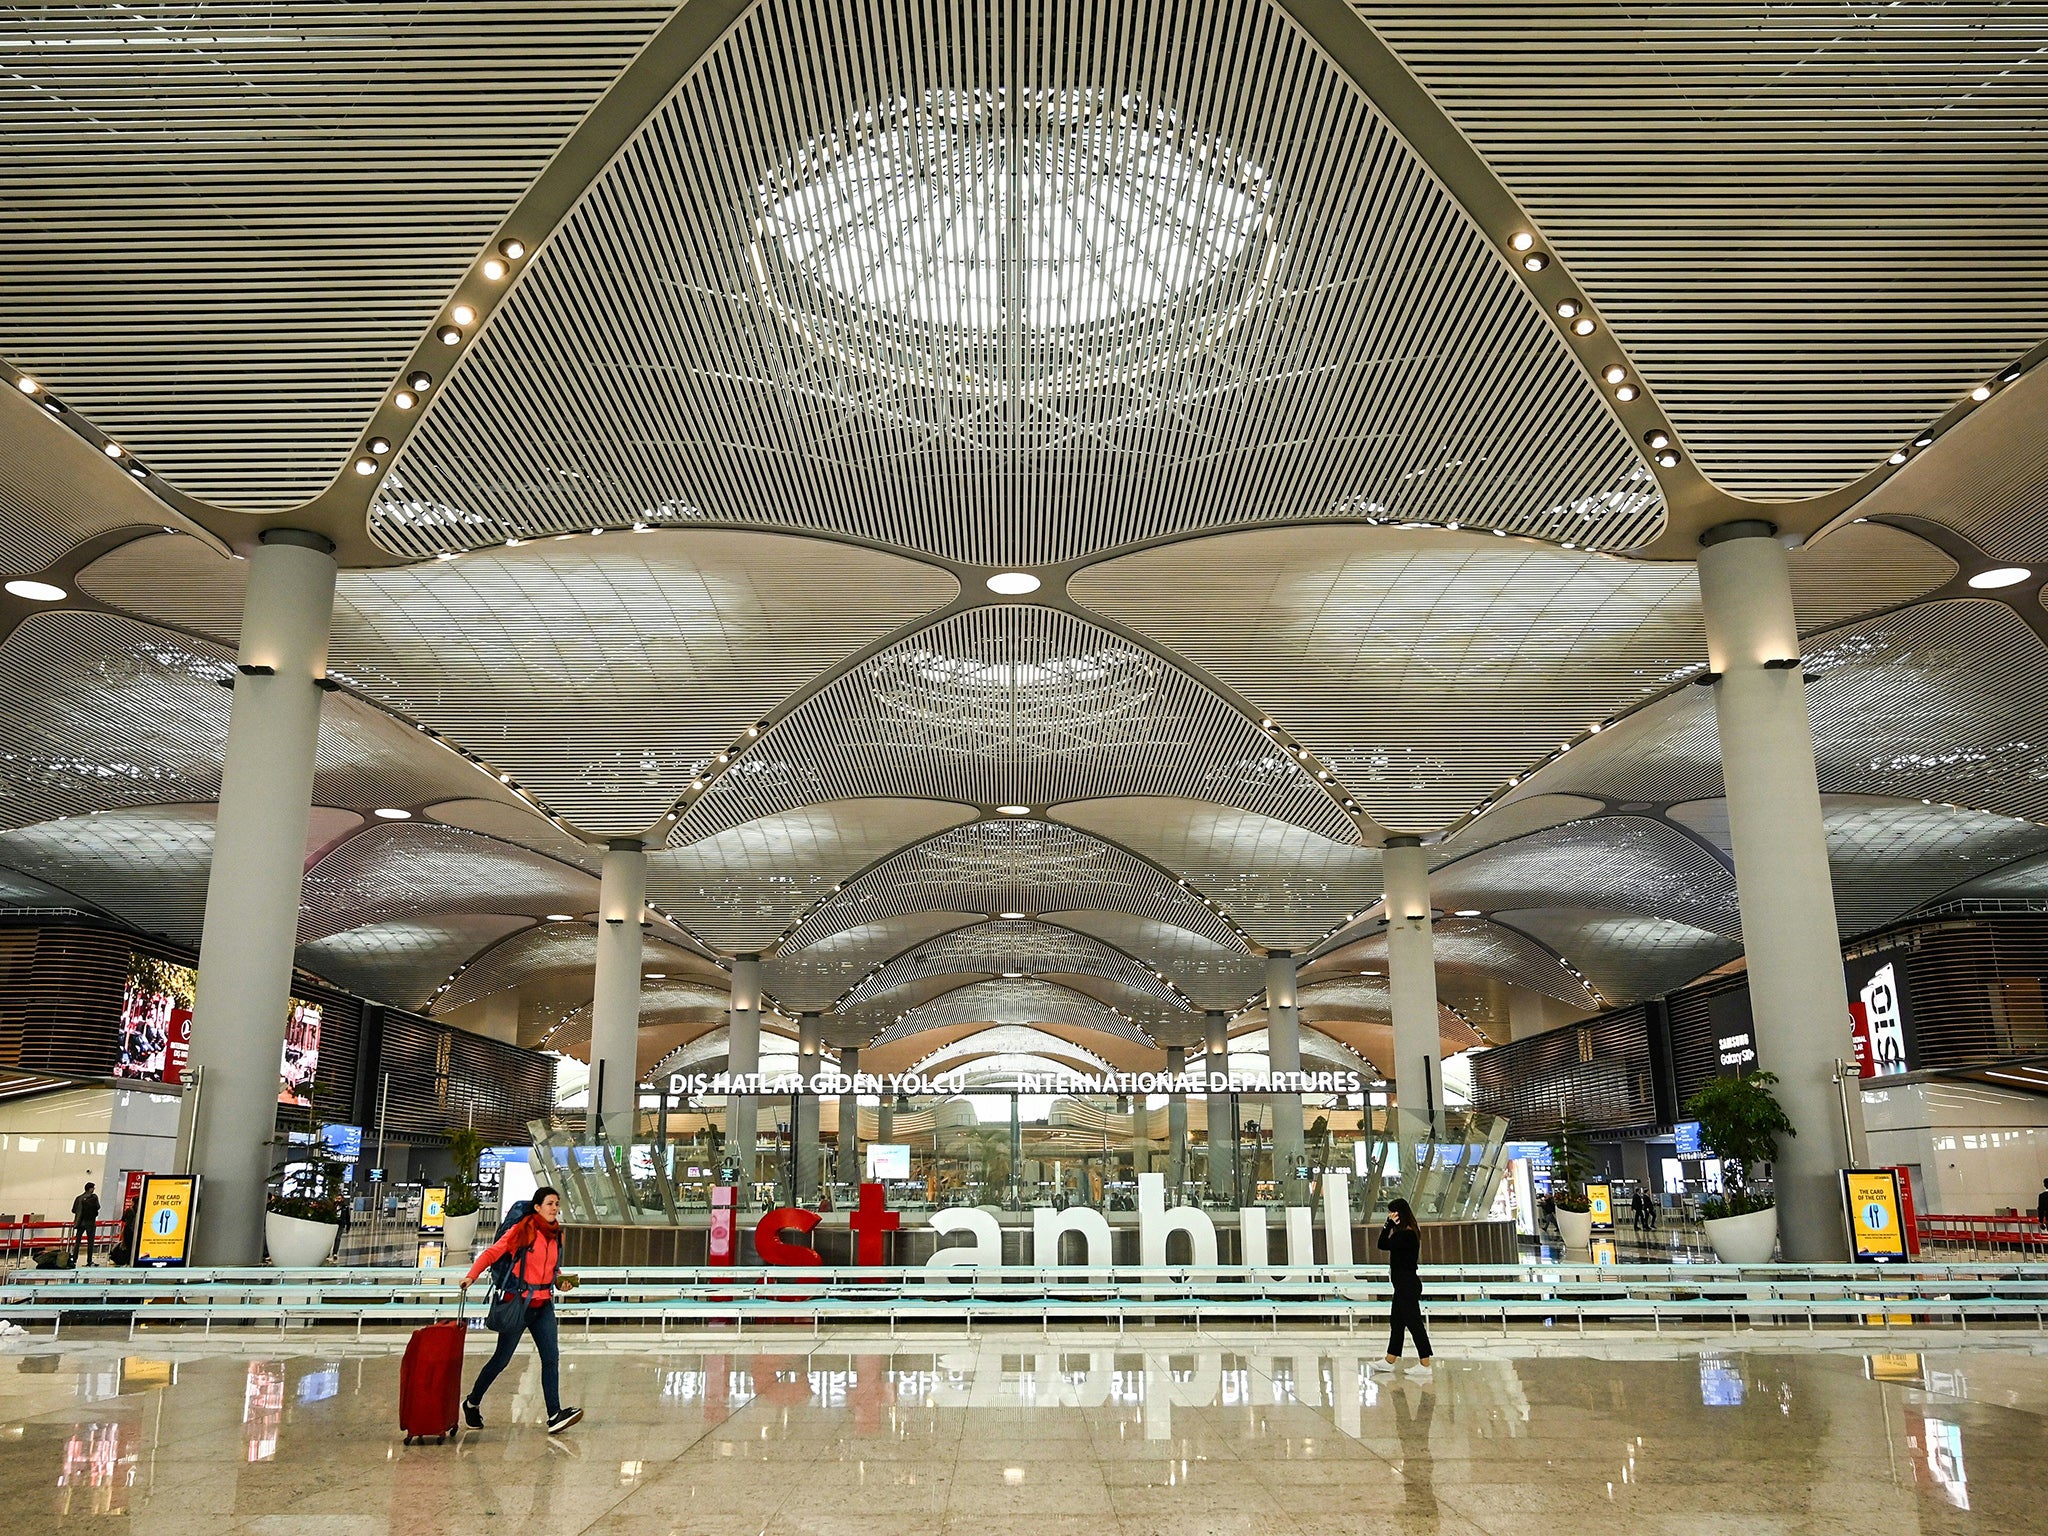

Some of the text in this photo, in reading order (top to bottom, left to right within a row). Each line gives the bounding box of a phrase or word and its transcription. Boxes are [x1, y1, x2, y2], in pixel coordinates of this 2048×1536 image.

[1718, 1033, 1749, 1051] SAMSUNG
[1720, 1053, 1742, 1066] Galaxy
[669, 1073, 708, 1099] DIŞ
[712, 1073, 804, 1094] HATLAR
[887, 1073, 965, 1094] YOLCU
[1017, 1071, 1361, 1093] INTERNATIONAL DEPARTURES
